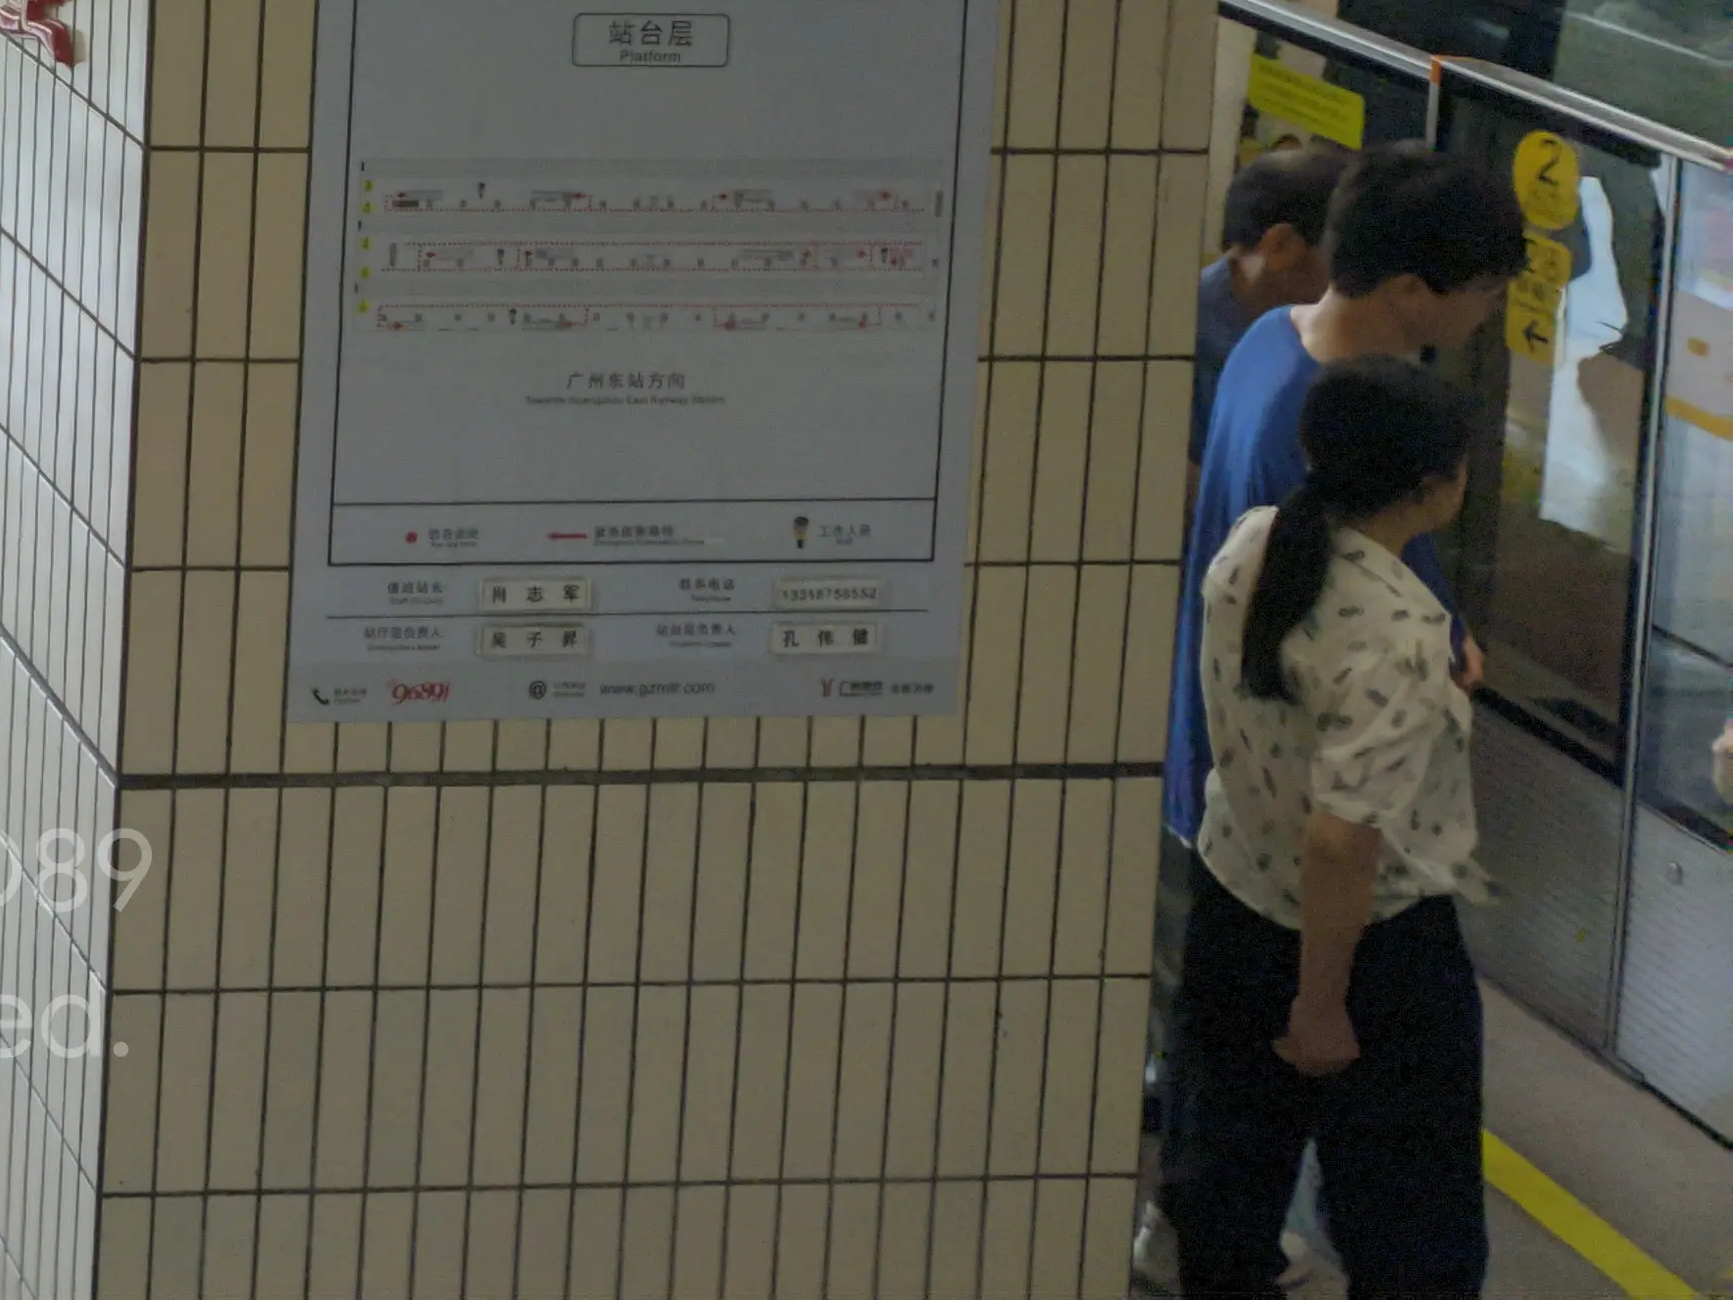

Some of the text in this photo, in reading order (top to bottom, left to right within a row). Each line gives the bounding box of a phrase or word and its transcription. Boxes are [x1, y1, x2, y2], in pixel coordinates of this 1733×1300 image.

[608, 19, 693, 47] 站台层
[619, 49, 682, 64] Platform
[565, 371, 687, 390] 广州东站方向
